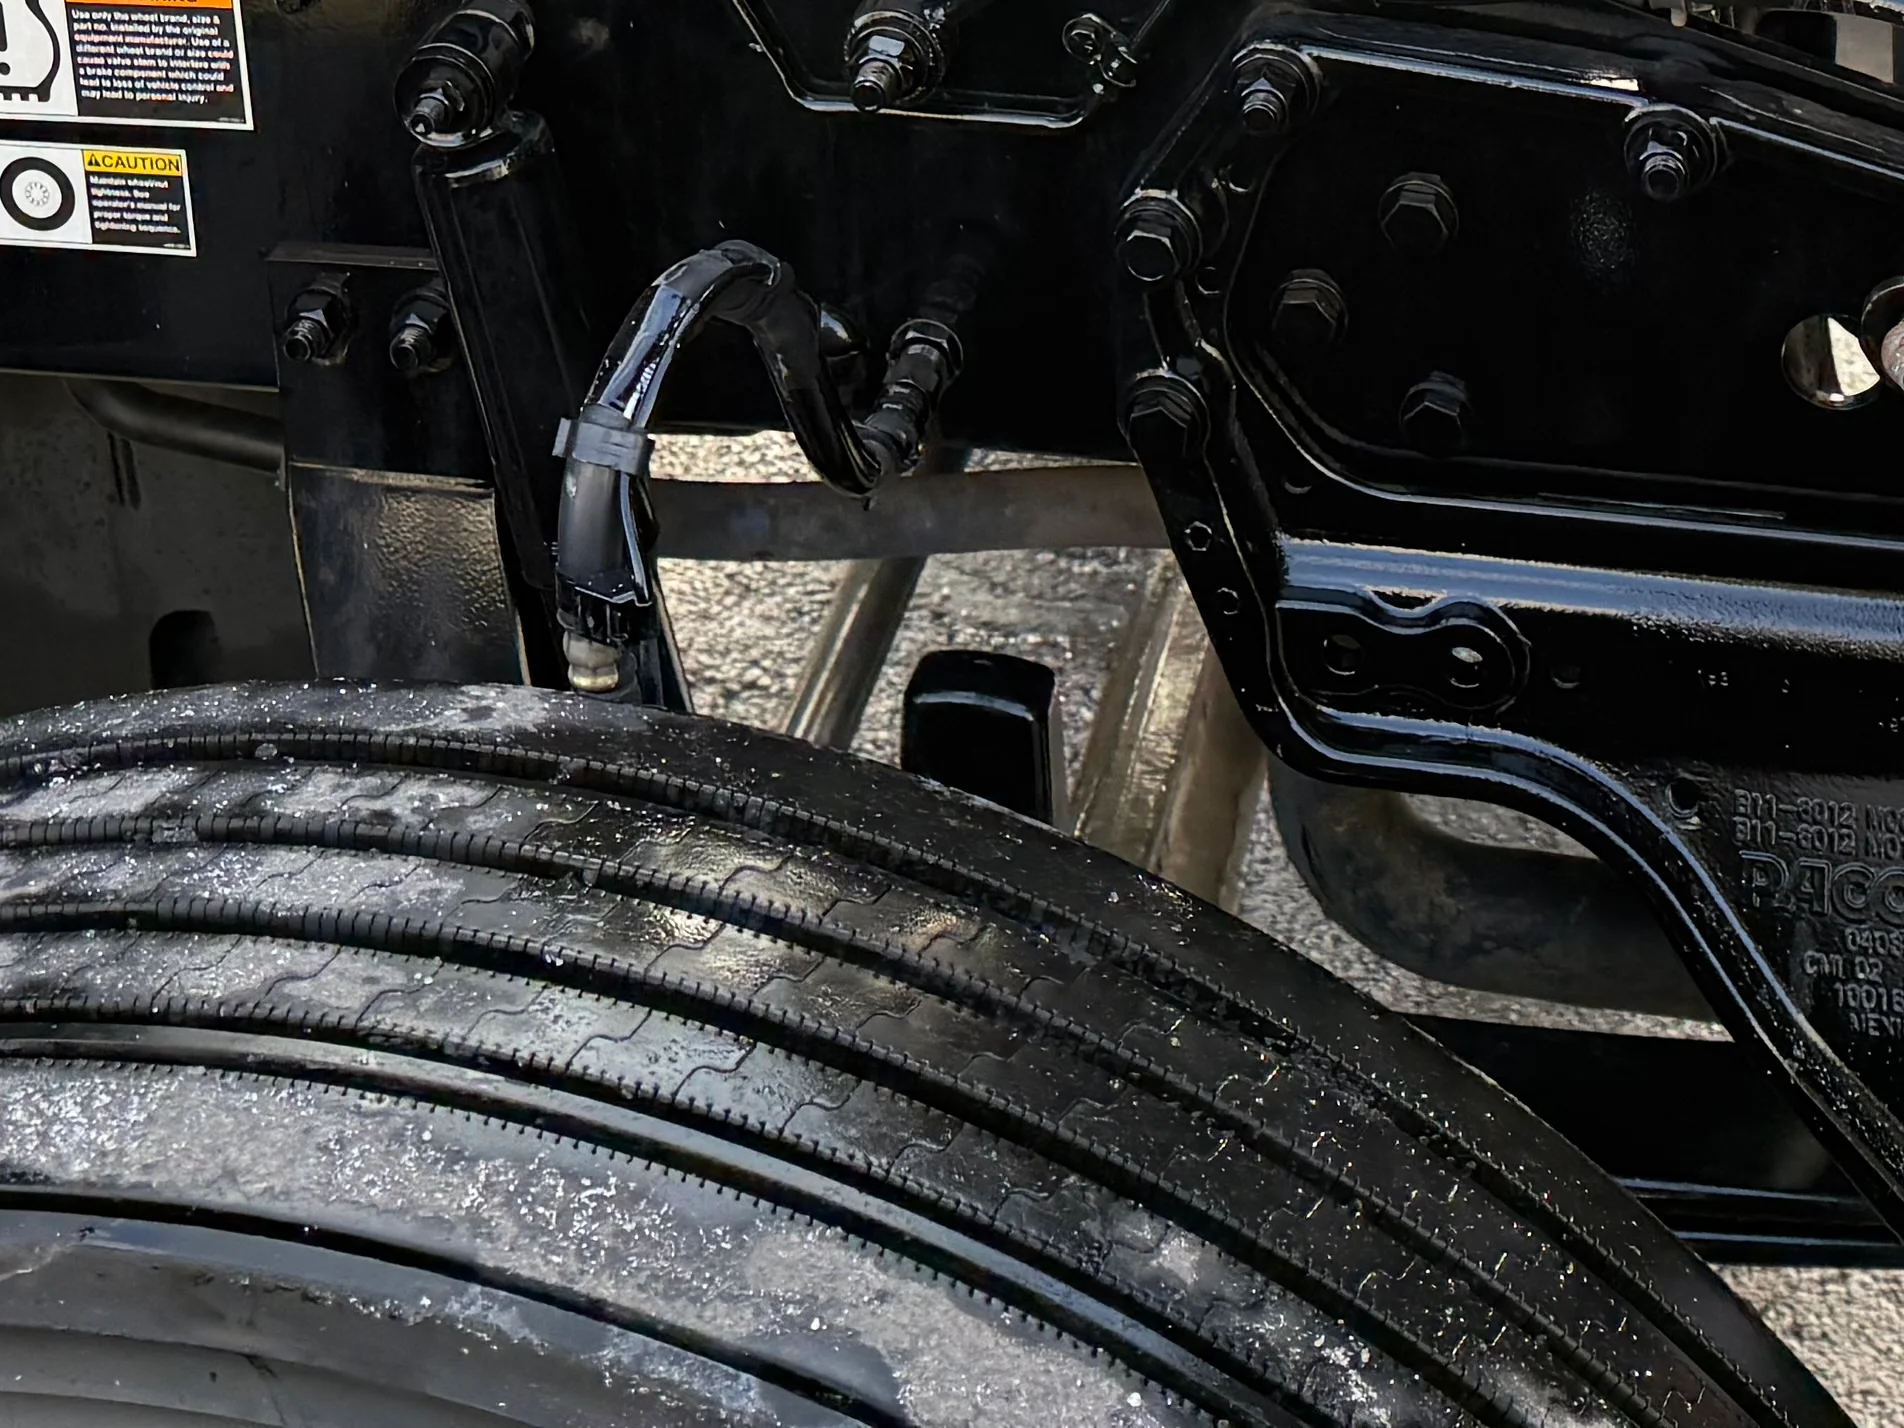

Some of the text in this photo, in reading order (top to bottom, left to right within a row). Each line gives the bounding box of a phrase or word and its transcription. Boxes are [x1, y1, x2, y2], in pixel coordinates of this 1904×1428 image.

[71, 9, 90, 19] Use
[92, 11, 111, 21] only
[113, 11, 129, 21] the
[131, 12, 158, 22] wheel
[160, 13, 190, 24] brand,
[192, 15, 210, 24] size
[73, 22, 92, 32] part
[110, 22, 150, 33] installed
[152, 24, 164, 35] by
[165, 24, 181, 34] the
[183, 25, 218, 36] original
[74, 34, 123, 43] equipment
[191, 37, 210, 47] Use
[212, 38, 222, 47] of
[76, 45, 114, 54] different
[116, 46, 143, 55] wheel
[146, 47, 173, 56] brand
[187, 49, 206, 57] size
[208, 50, 234, 59] could
[77, 56, 231, 70] cause valve stem to interfere with
[86, 67, 112, 76] brake
[114, 69, 166, 79] component
[168, 71, 196, 80] which
[198, 72, 224, 81] could
[79, 78, 234, 92] lead to loss of vehicle control and
[81, 90, 101, 100] may
[103, 89, 122, 99] lead
[124, 90, 134, 99] to
[136, 91, 176, 102] personal
[102, 155, 180, 171] CAUTION
[136, 202, 167, 210] manual
[168, 203, 181, 211] for
[93, 211, 168, 221] proper torque and
